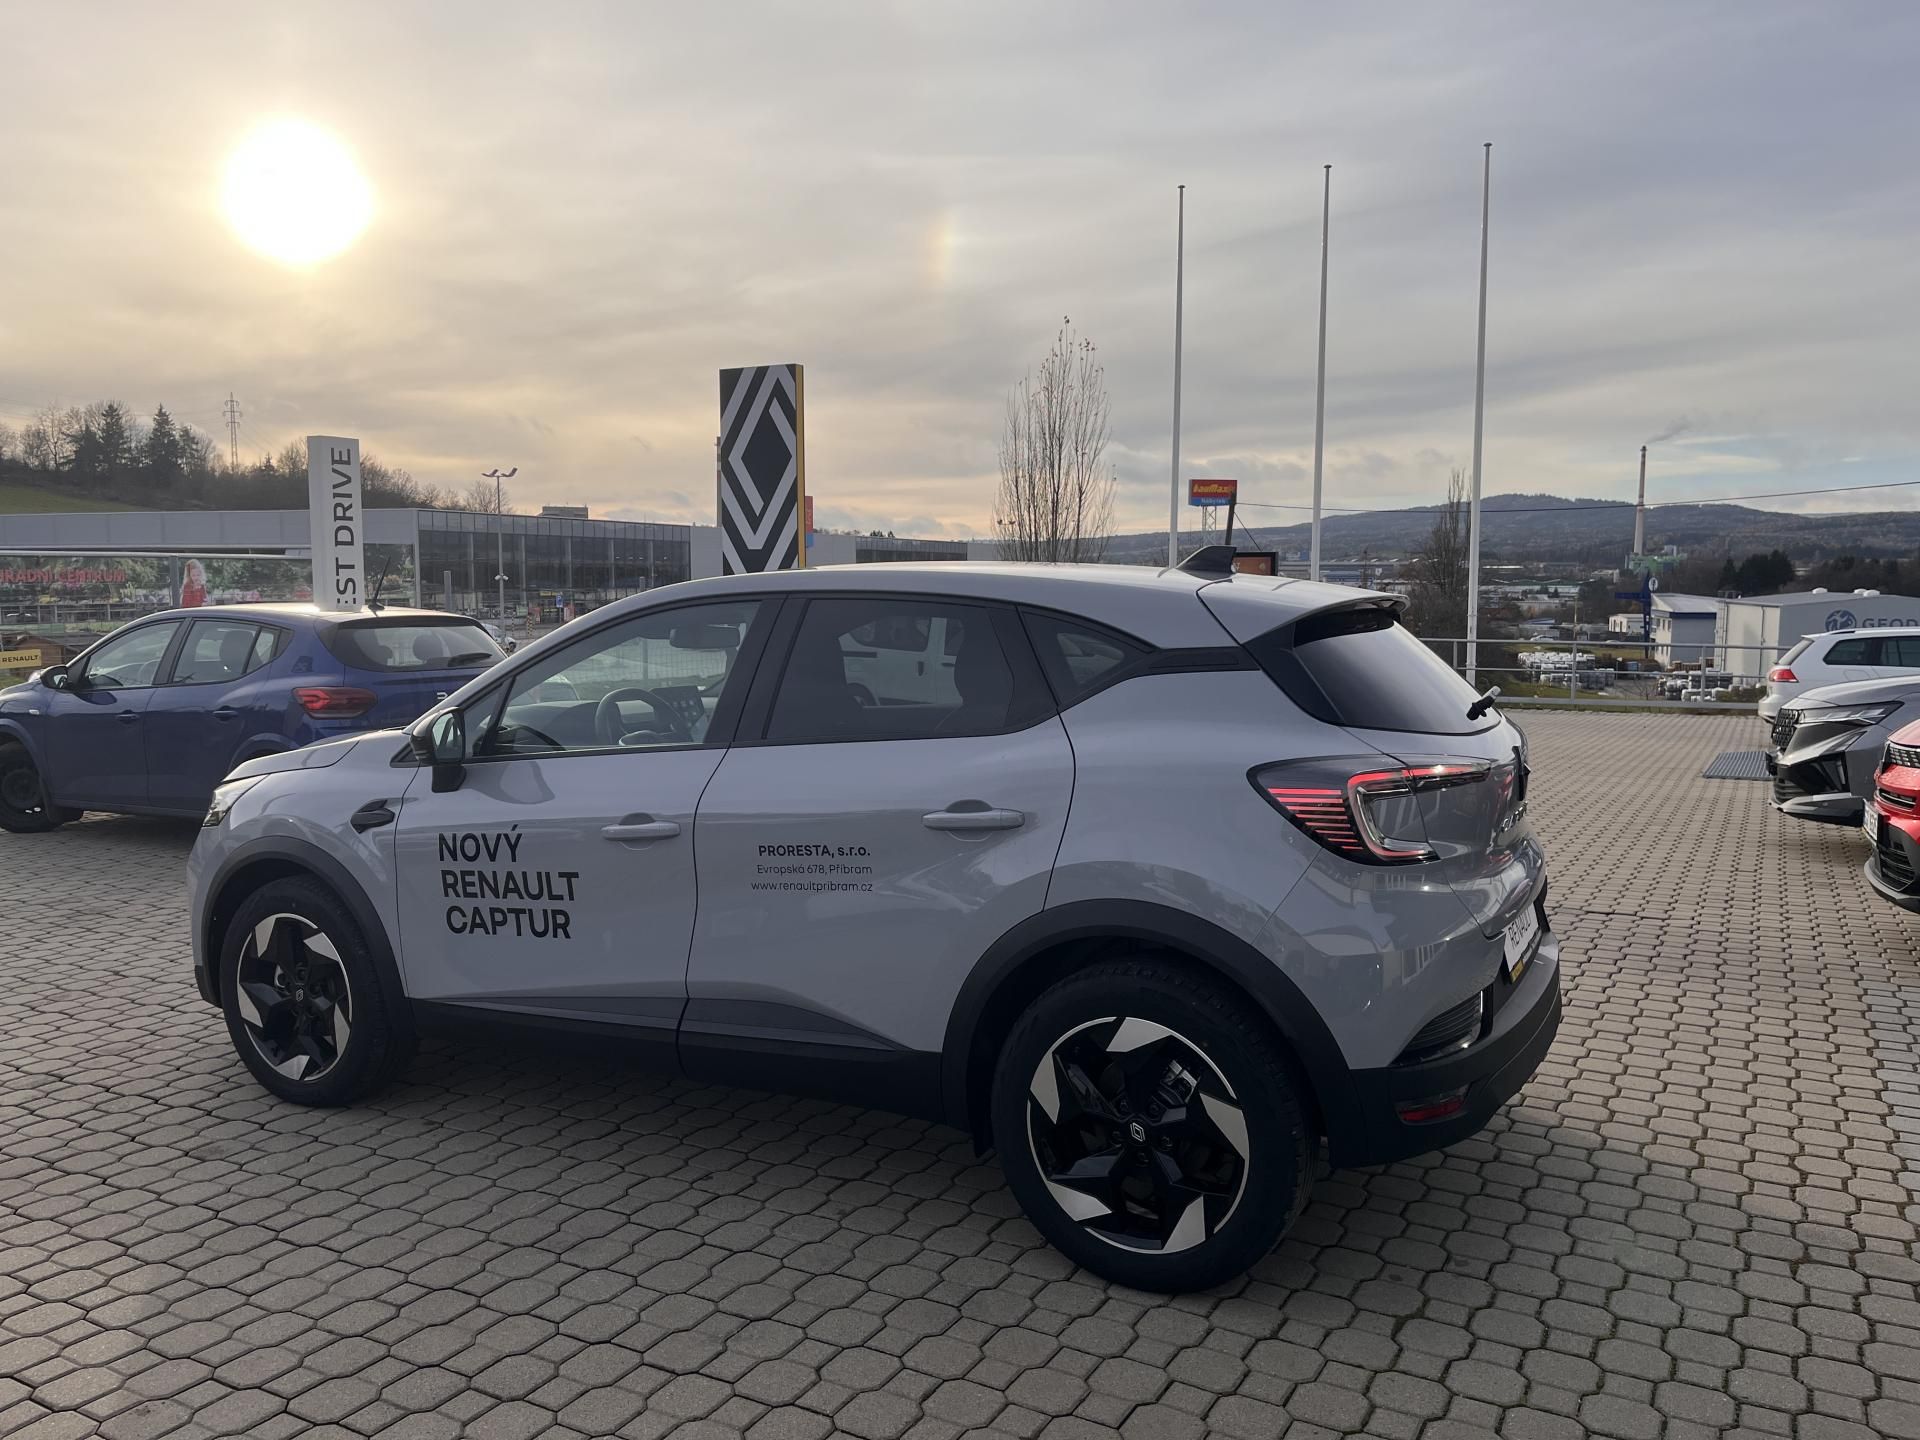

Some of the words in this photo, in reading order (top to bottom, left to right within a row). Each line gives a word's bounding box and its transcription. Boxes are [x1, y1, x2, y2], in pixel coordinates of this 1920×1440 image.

[330, 447, 355, 547] DRIVE
[58, 568, 127, 583] CENTRUM
[438, 824, 523, 863] NOVÝ
[758, 845, 835, 858] PRORESTA,
[837, 846, 871, 857] s.r.o.
[757, 863, 805, 876] Evropská
[807, 864, 827, 876] 678,
[829, 863, 873, 874] Příbram
[440, 869, 579, 901] RENAULT
[751, 881, 873, 893] www.renaultpribram.cz
[446, 905, 571, 939] CAPTUR
